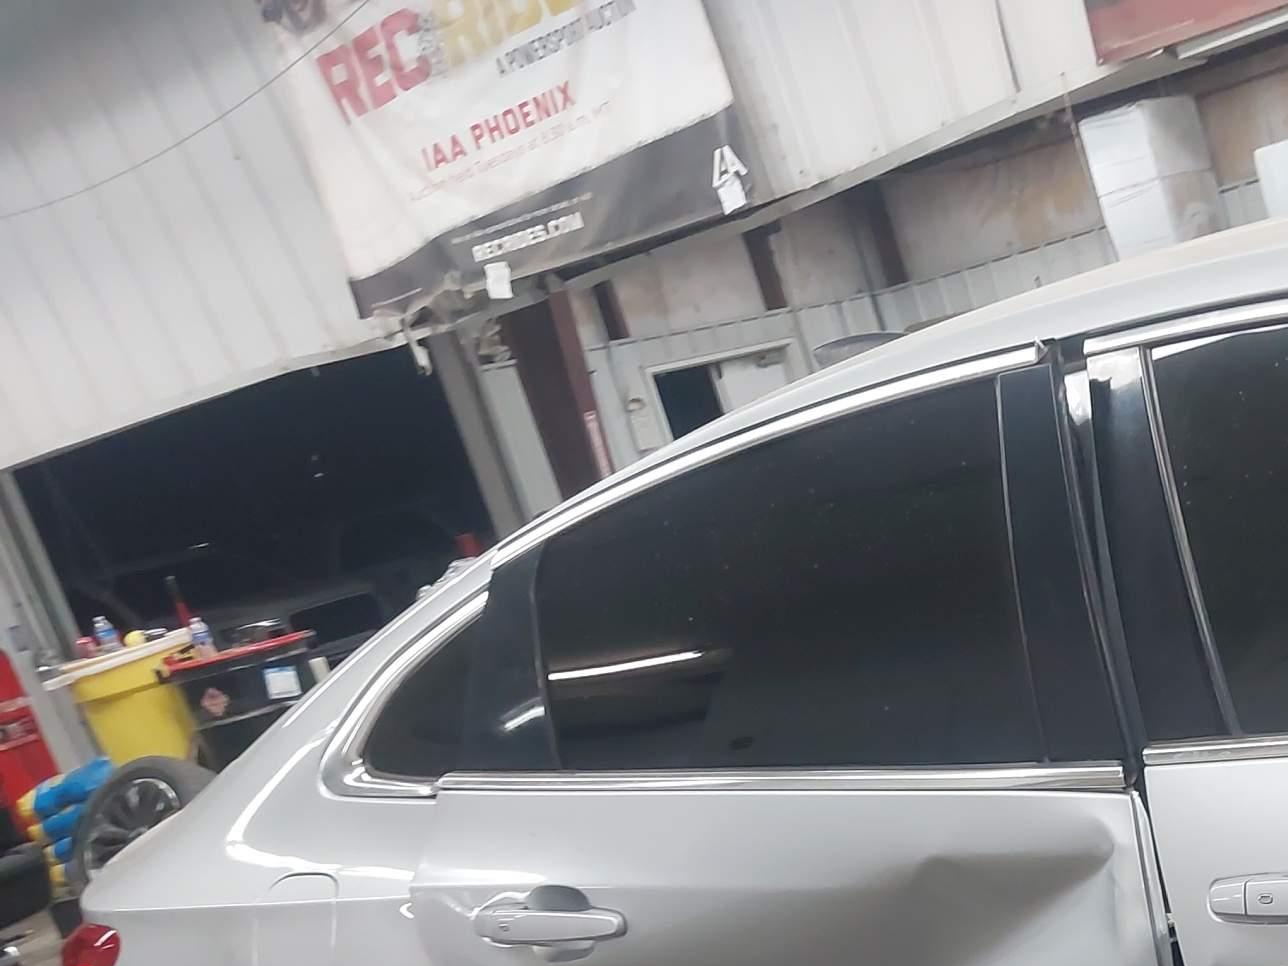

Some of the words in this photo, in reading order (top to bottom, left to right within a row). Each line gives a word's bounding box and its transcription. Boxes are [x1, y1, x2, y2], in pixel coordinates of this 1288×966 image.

[318, 7, 431, 124] REC
[434, 0, 585, 66] RID
[421, 134, 468, 172] IAA
[469, 80, 576, 150] PHOENIX
